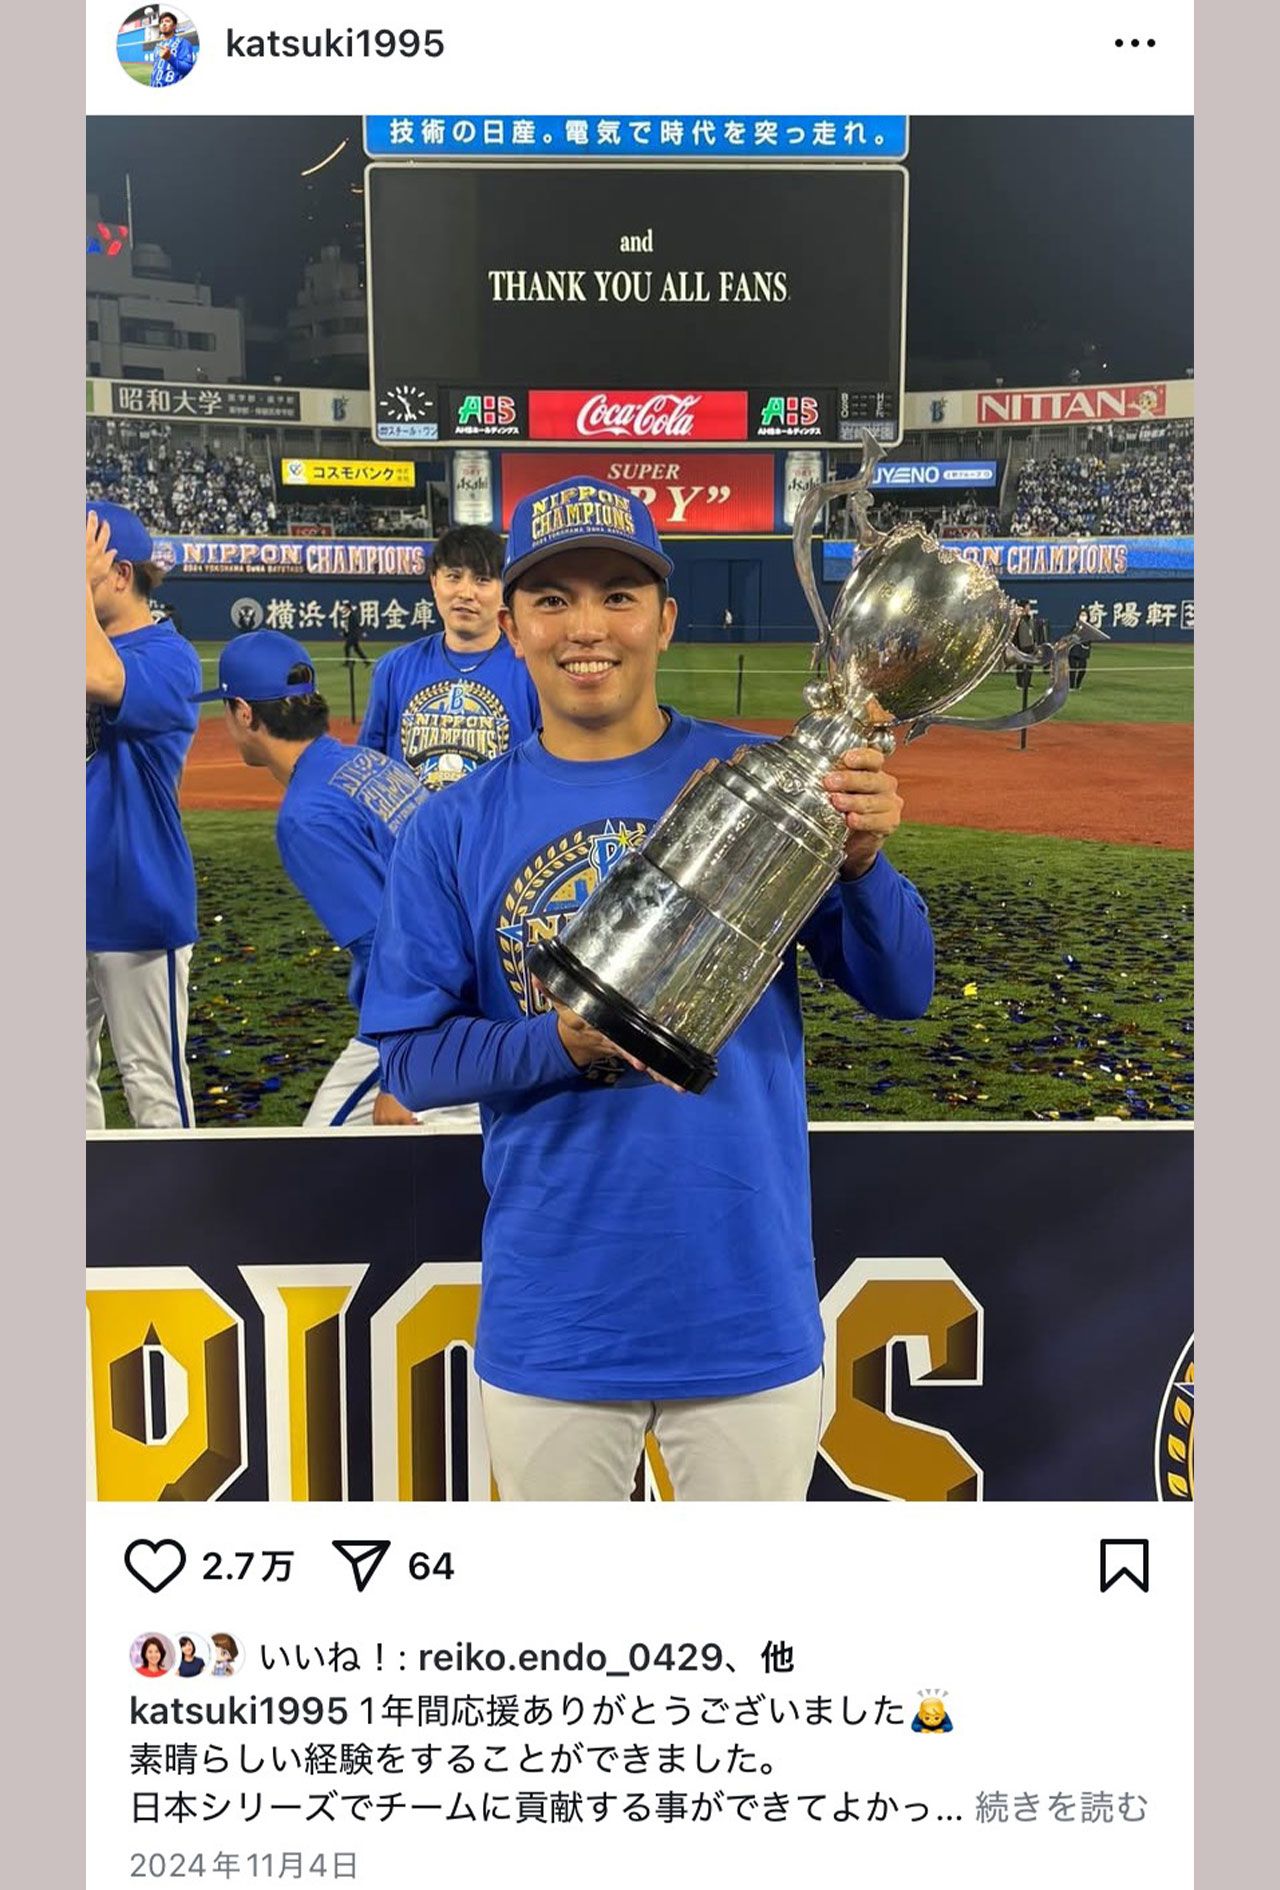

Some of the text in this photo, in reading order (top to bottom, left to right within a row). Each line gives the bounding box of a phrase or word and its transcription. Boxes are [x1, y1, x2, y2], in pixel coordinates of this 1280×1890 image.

[390, 118, 885, 146] 技術の日産。電気で時代を突っ走れ。
[621, 229, 653, 252] and
[489, 271, 586, 300] THANK
[594, 271, 652, 301] YOU
[660, 272, 710, 301] ALL
[119, 387, 222, 416] 昭和大学
[576, 393, 702, 436] Coca-Cola
[981, 389, 1126, 421] NITTAN
[313, 466, 394, 481] コスモバンク
[608, 463, 680, 480] SUPER
[532, 486, 630, 517] NIPPON
[532, 502, 636, 541] CHAMPIONS
[182, 543, 304, 565] NIPPON
[306, 545, 425, 575] CHAMPIONS
[1007, 545, 1127, 575] CHAMPIONS
[415, 713, 496, 730] NIPPON
[408, 726, 498, 761] CHAMPIONS
